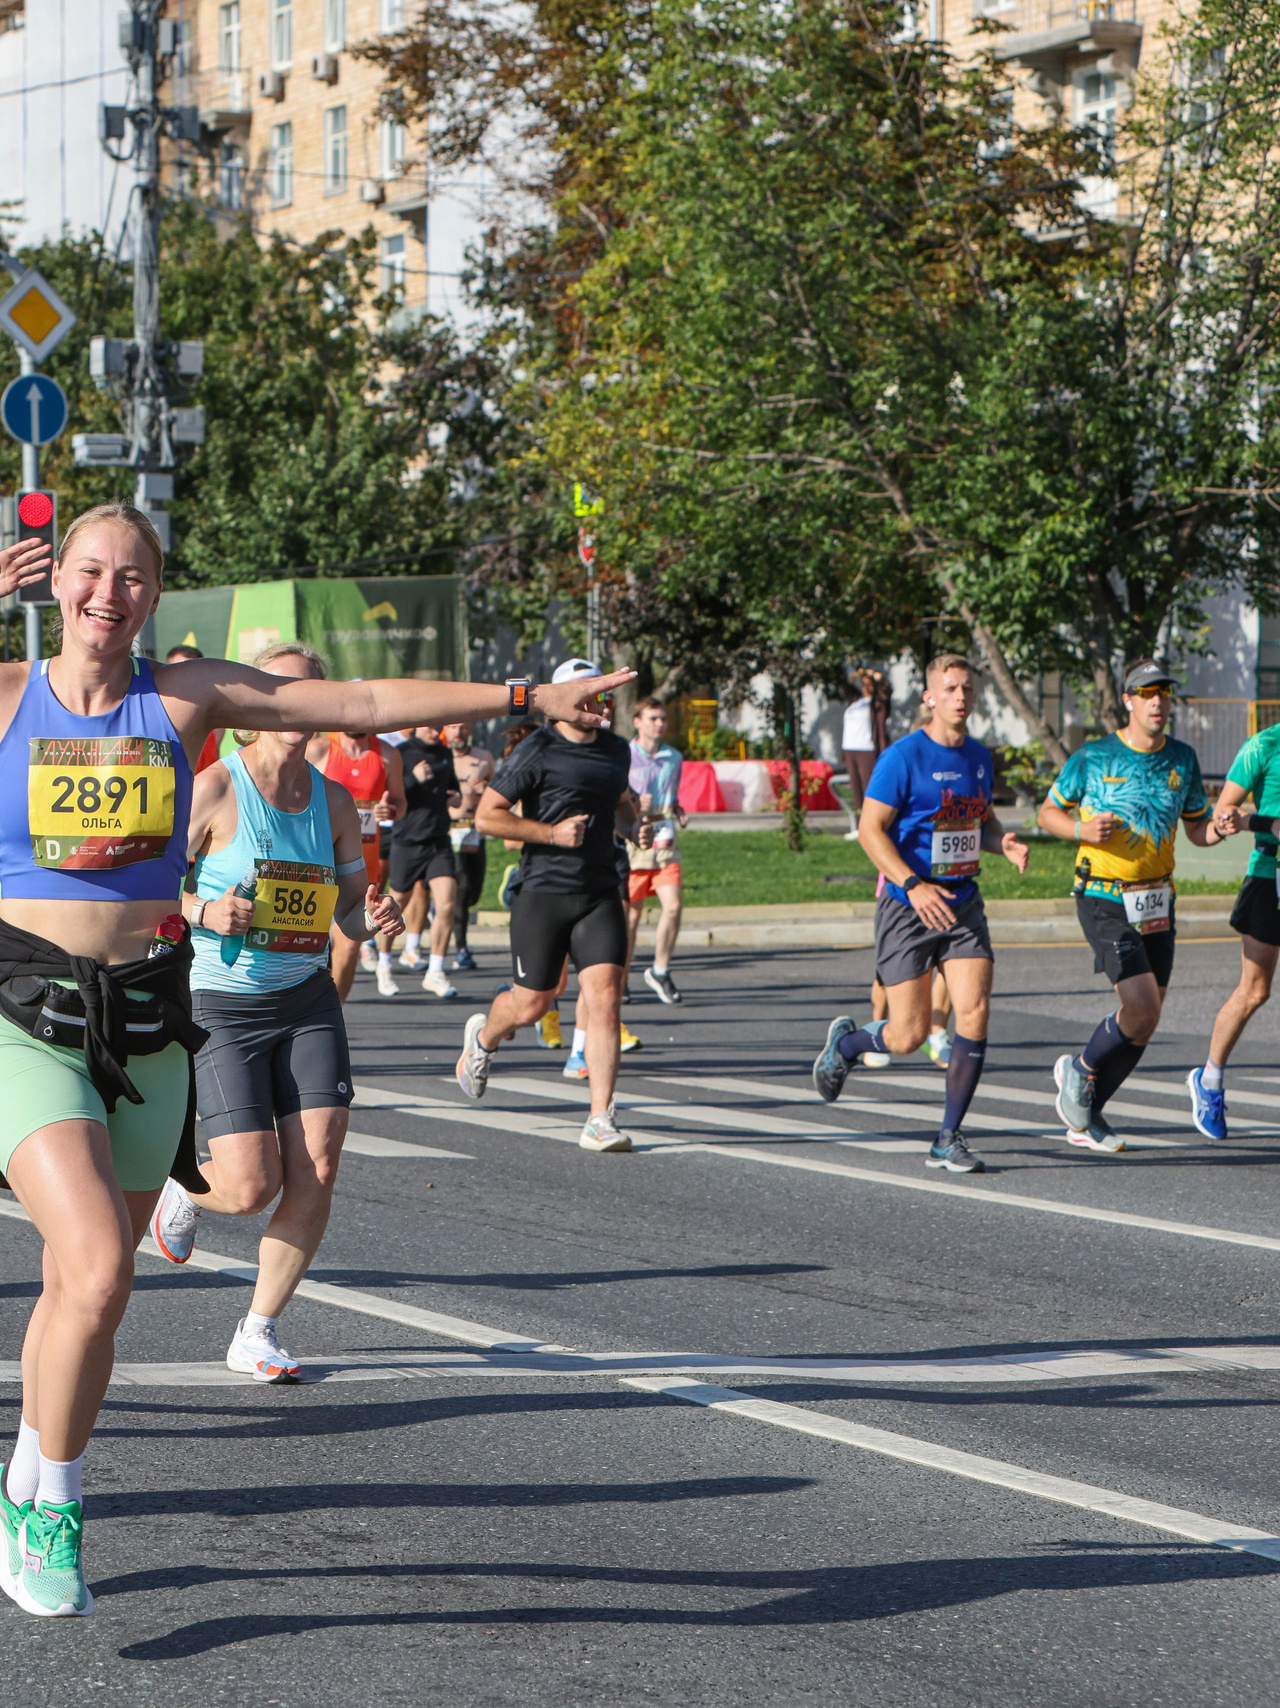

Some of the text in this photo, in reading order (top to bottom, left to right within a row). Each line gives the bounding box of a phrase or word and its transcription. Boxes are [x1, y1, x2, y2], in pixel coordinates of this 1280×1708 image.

[51, 775, 148, 814] 2891
[81, 818, 122, 829] ОЛЬГА
[46, 839, 61, 860] D
[942, 835, 976, 853] 5980
[937, 864, 946, 874] D
[273, 887, 317, 916] 586
[1135, 892, 1164, 911] 6134
[272, 916, 315, 927] АНАСТАСИЯ
[258, 930, 269, 945] D
